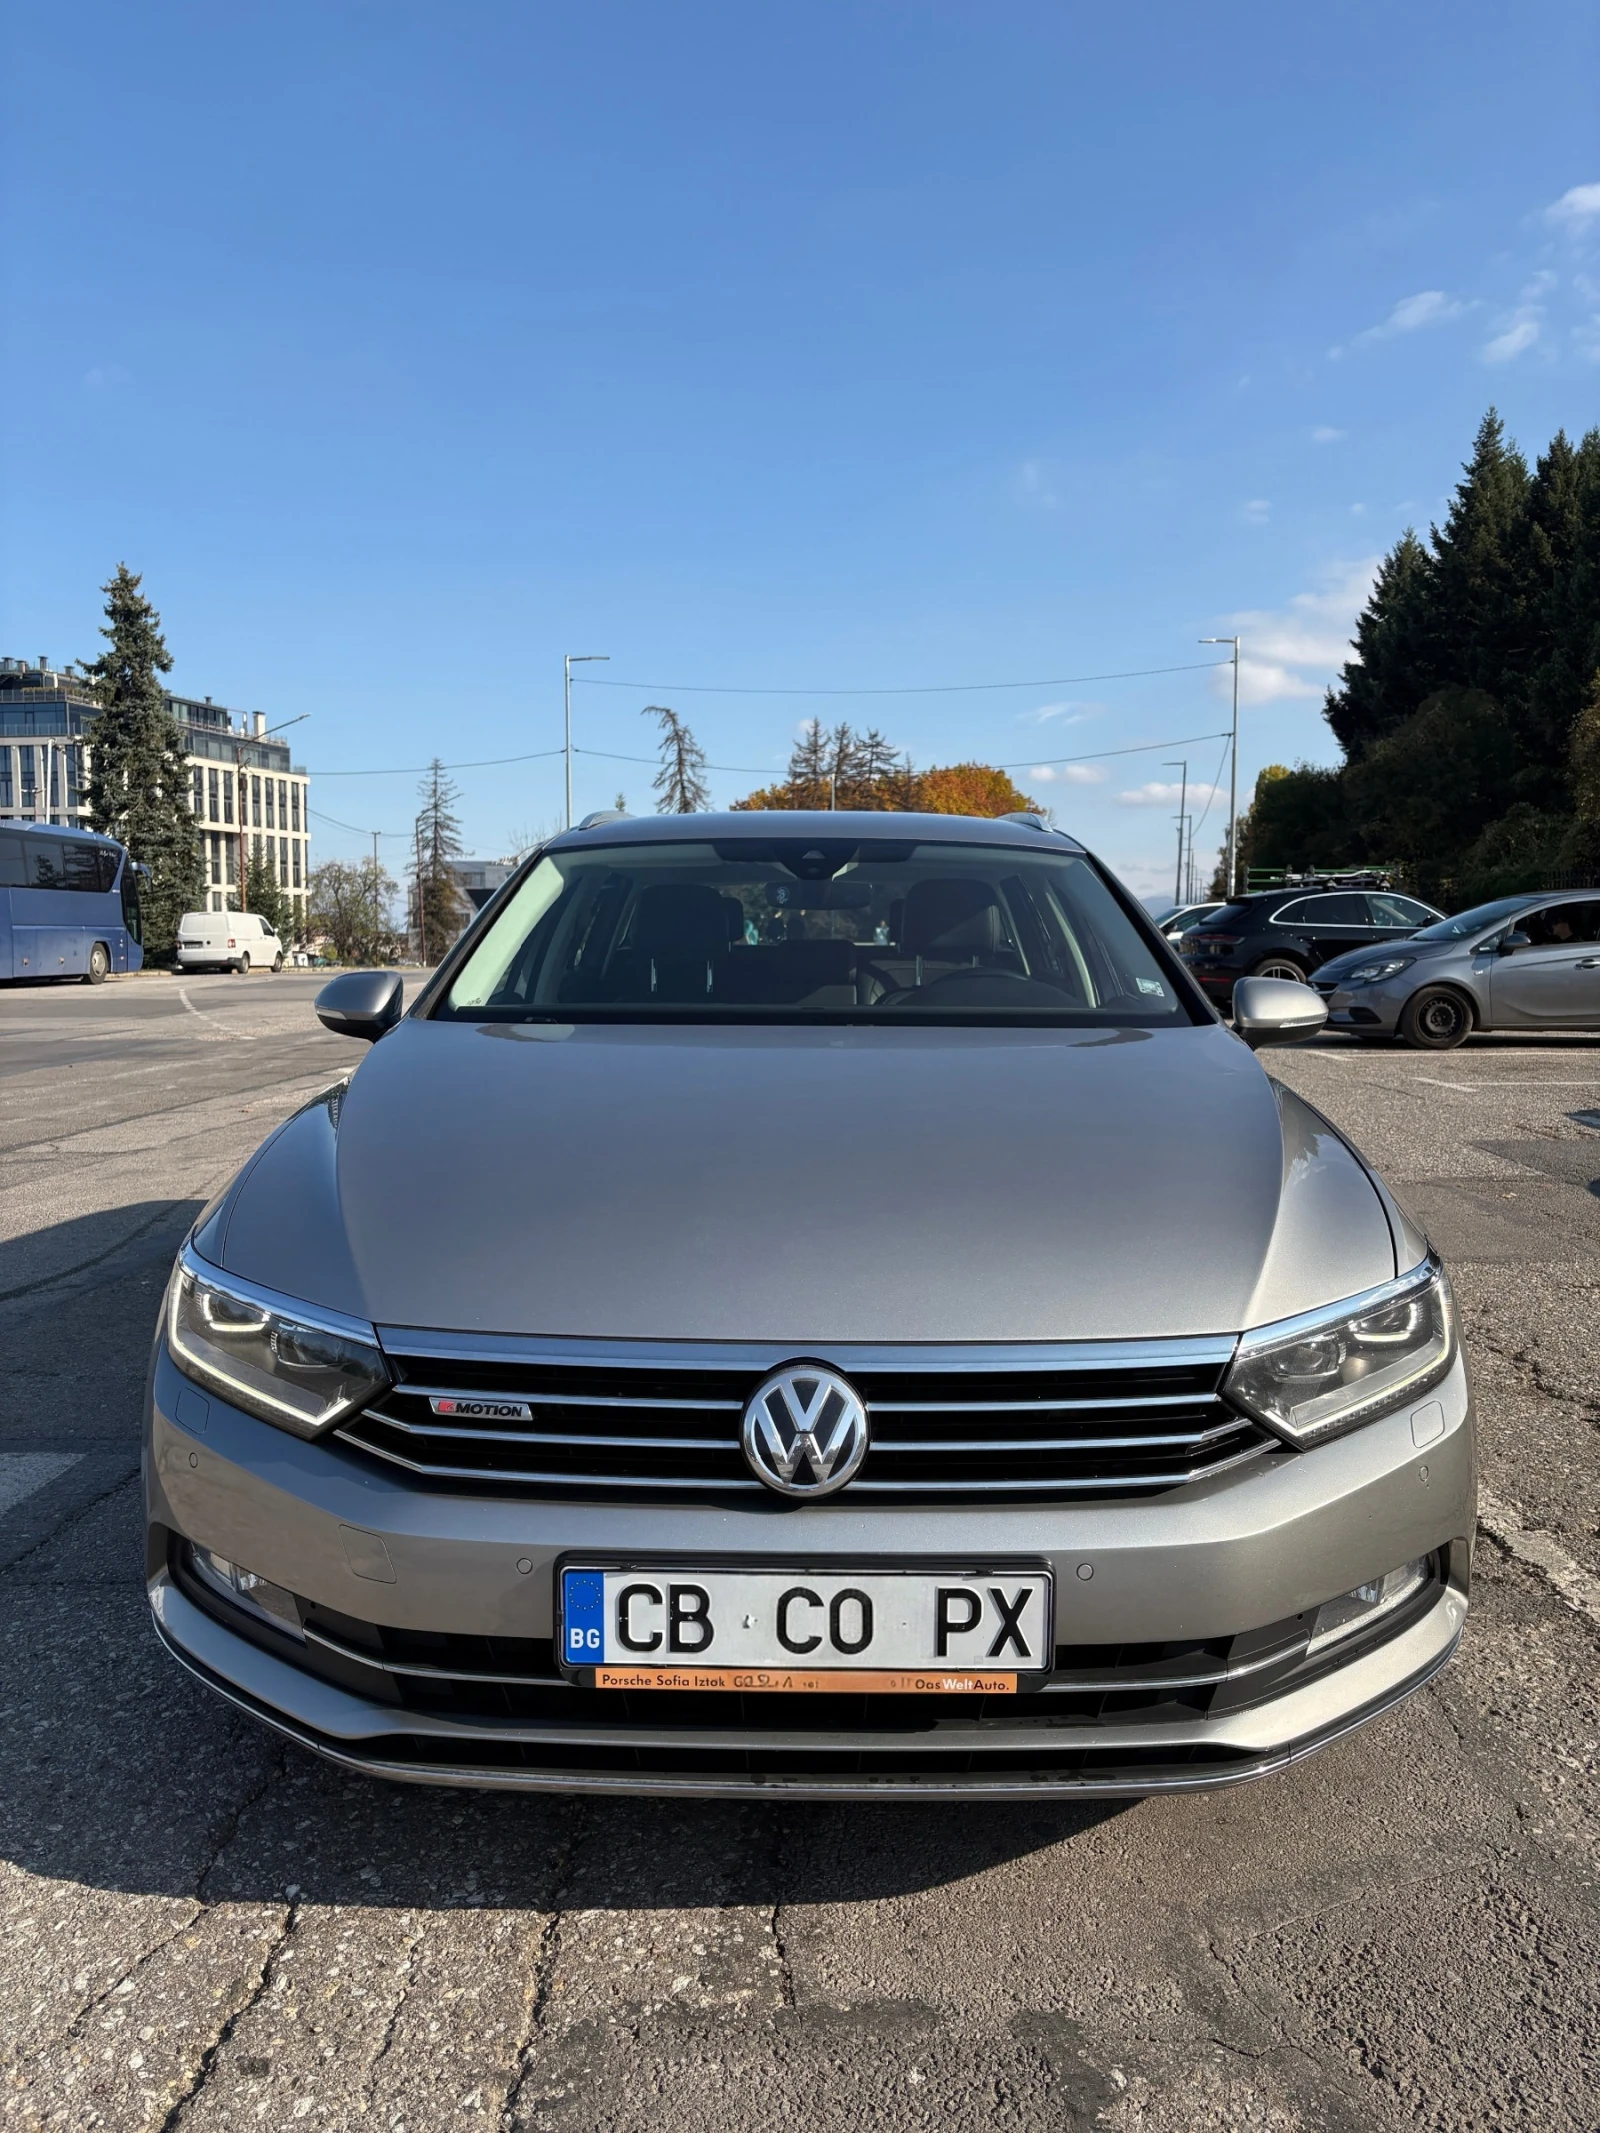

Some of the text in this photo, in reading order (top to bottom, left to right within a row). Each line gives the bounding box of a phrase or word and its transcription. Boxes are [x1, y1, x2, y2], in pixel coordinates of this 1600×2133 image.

[749, 1371, 865, 1491] VW
[570, 1628, 600, 1649] BG
[618, 1583, 715, 1653] CB
[936, 1587, 1034, 1657] PX
[602, 1674, 652, 1686] Porsche
[656, 1675, 690, 1687] Sofia
[695, 1675, 725, 1687] Iztok
